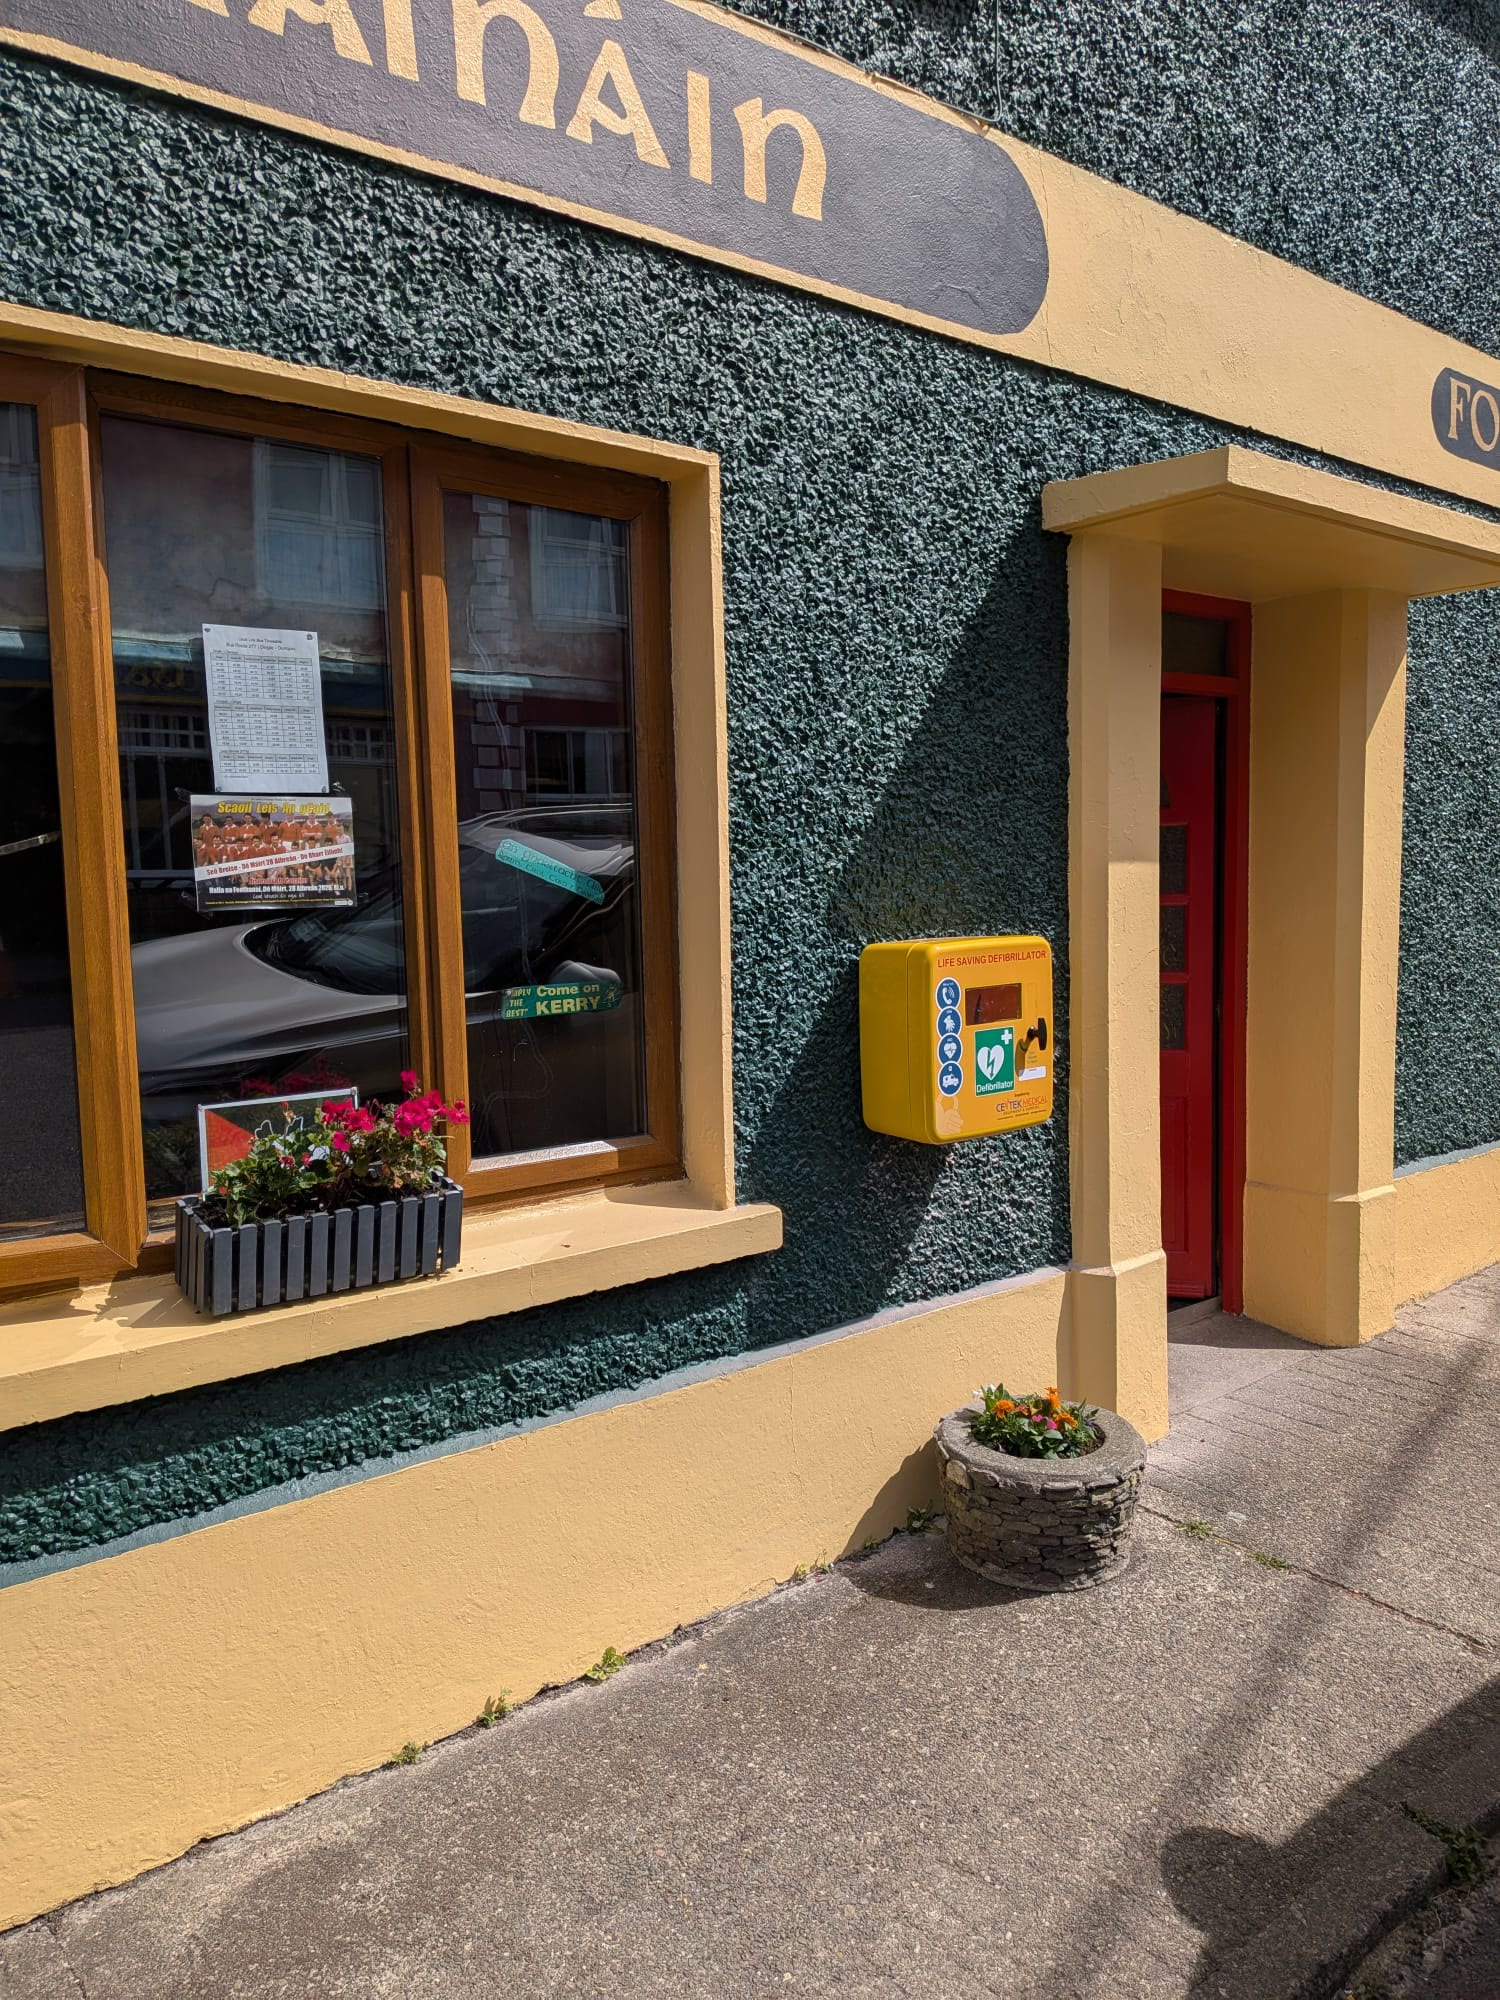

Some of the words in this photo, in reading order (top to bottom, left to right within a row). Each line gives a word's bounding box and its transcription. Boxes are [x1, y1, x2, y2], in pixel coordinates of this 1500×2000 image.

[937, 957, 956, 968] LIFE
[956, 954, 987, 967] SAVING
[988, 950, 1047, 964] DEFIBRILLATOR
[536, 984, 579, 997] Come
[583, 983, 600, 993] on
[509, 998, 524, 1007] THE
[535, 995, 601, 1017] KERRY
[976, 1079, 1014, 1093] Defibrillator
